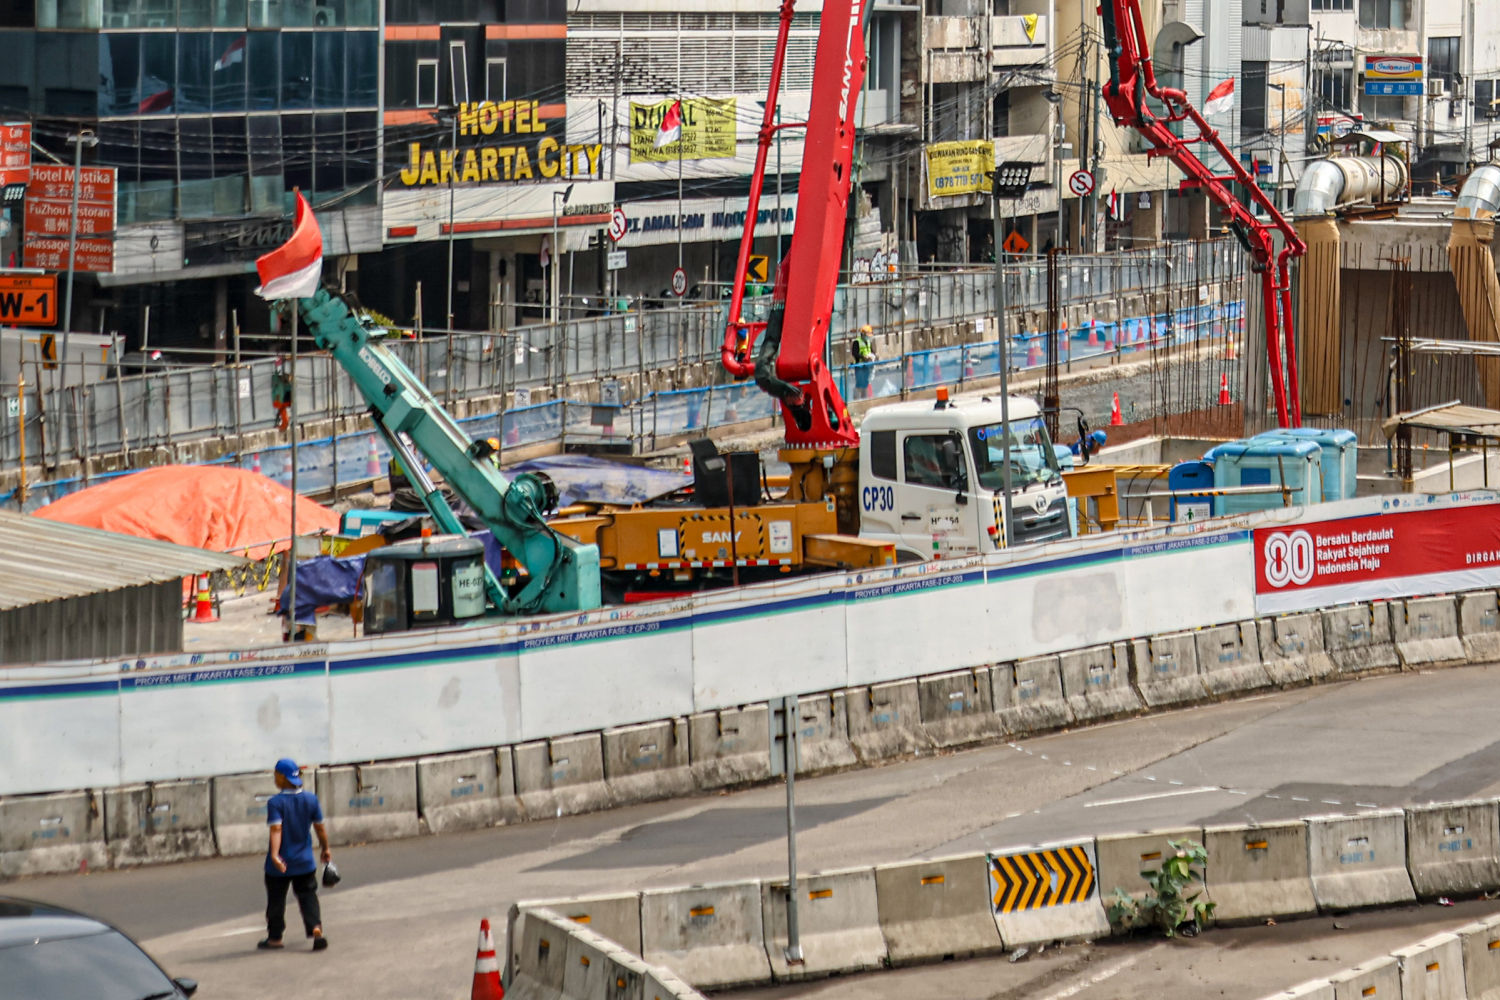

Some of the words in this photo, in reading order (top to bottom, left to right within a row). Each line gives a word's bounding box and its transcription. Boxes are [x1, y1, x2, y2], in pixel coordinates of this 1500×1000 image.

[459, 100, 547, 135] HOTEL
[401, 142, 533, 186] JAKARTA
[538, 136, 602, 178] CITY
[31, 168, 62, 182] Hotel
[64, 169, 110, 185] Mstika
[30, 204, 67, 217] FuZhou
[26, 237, 69, 256] Massage
[358, 347, 391, 385] KOBELCO
[863, 486, 894, 512] CP30
[702, 530, 742, 543] SANY
[1316, 534, 1350, 547] Bersatu
[1352, 528, 1394, 543] Berdaulat
[1264, 529, 1315, 588] 80
[1316, 549, 1347, 562] Rakyat
[1349, 543, 1390, 558] Sejahtera
[1317, 561, 1359, 576] Indonesia
[1360, 557, 1380, 571] Maju
[855, 588, 881, 599] PROYEK
[881, 586, 894, 596] MRT
[894, 582, 921, 593] JAKARTA
[524, 637, 555, 649] PROYEK
[557, 634, 573, 644] MRT
[574, 629, 607, 641] JAKARTA
[608, 626, 634, 637] FASE-2
[134, 675, 171, 687] PROYEK
[173, 673, 192, 684] MRT
[194, 669, 233, 682] JAKARTA
